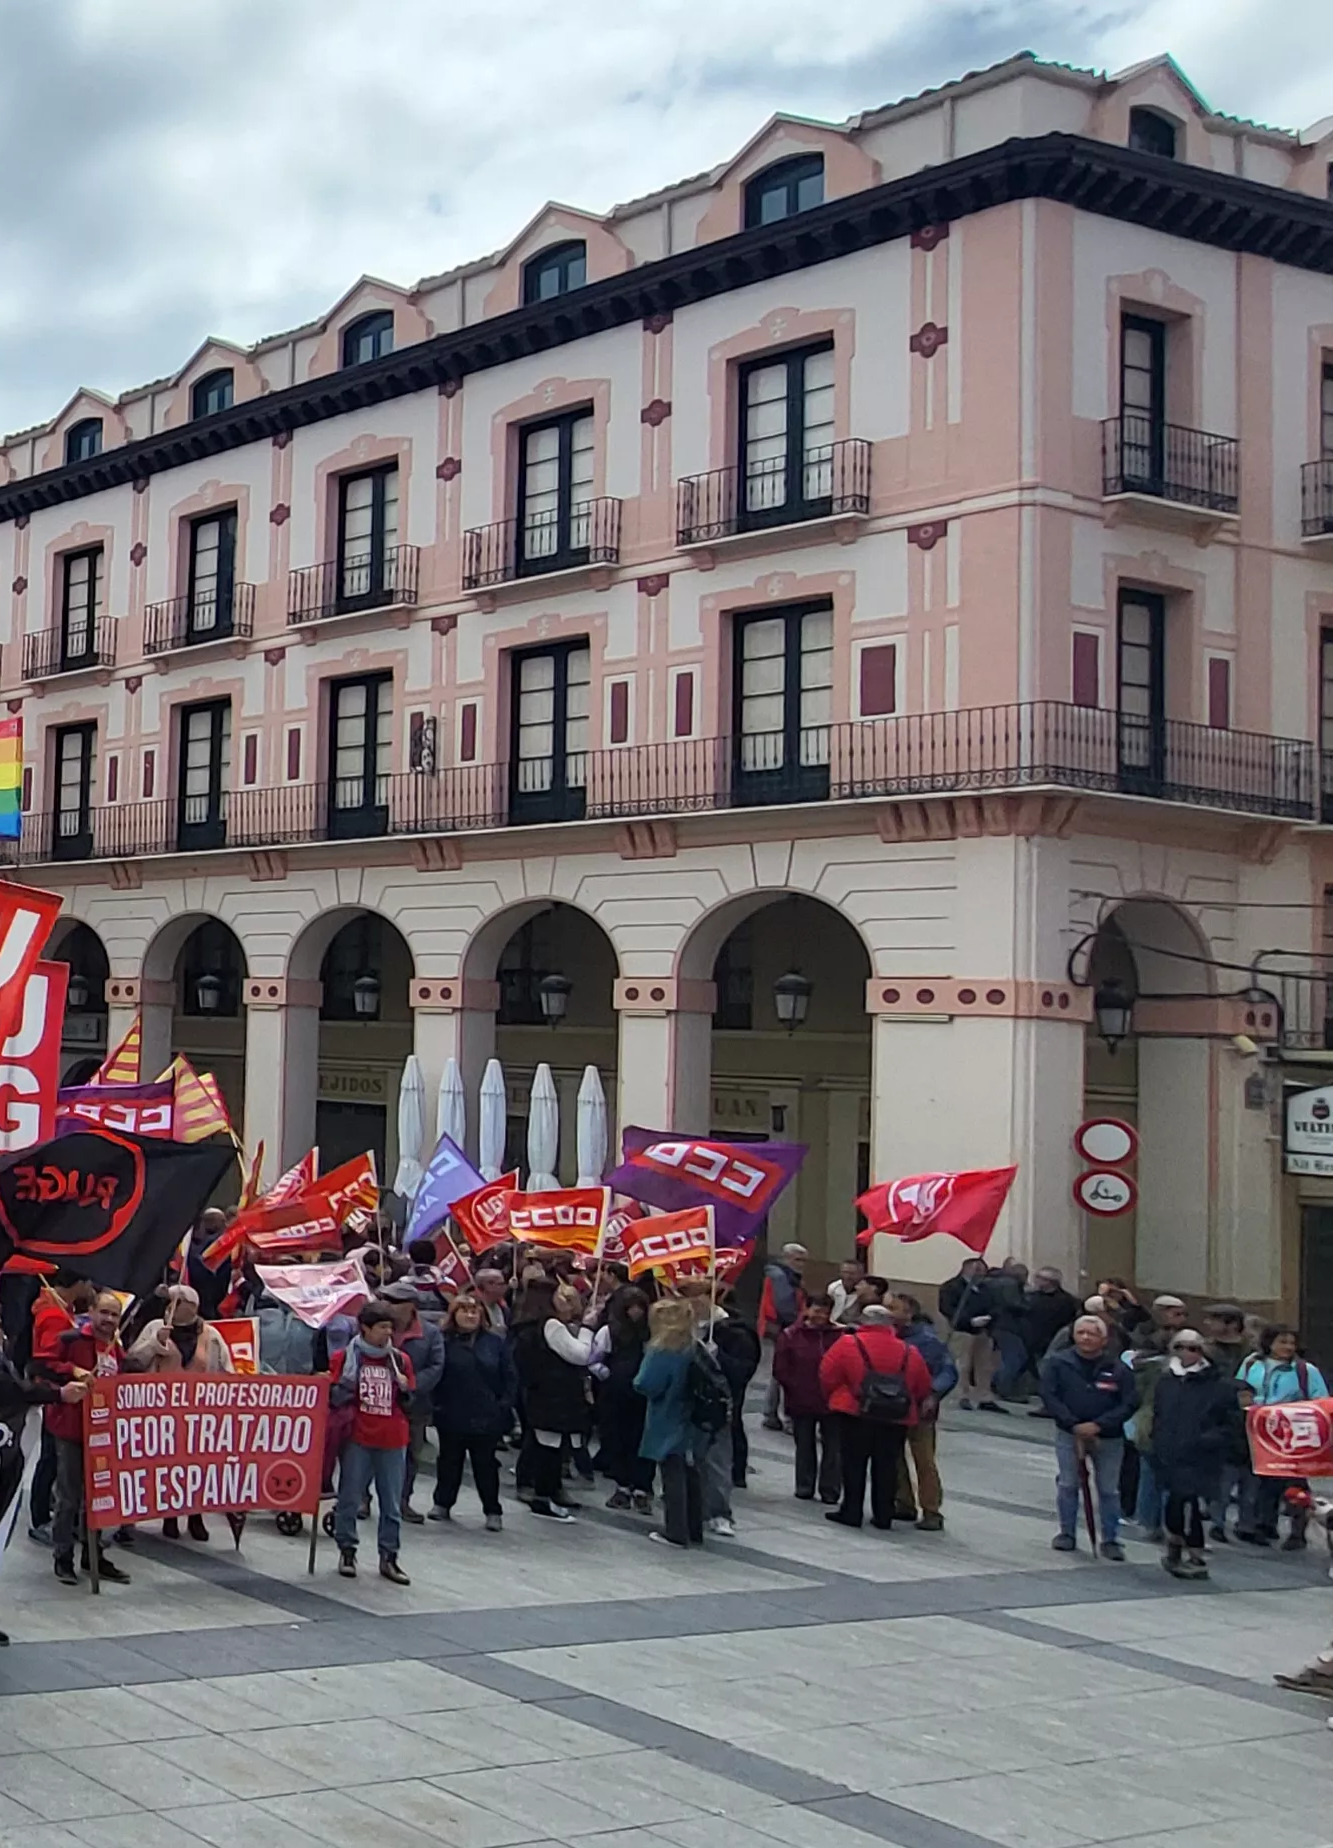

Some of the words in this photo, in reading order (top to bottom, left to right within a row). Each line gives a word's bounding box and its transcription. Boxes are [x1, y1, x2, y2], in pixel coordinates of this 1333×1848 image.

[319, 1074, 382, 1094] EJIDOS
[509, 1205, 598, 1228] CCOO
[116, 1382, 166, 1410] SOMOS
[171, 1382, 190, 1408] EL
[194, 1382, 318, 1409] PROFESORADO
[115, 1414, 176, 1460] PEOR
[184, 1413, 314, 1454] TRATADO
[118, 1468, 149, 1518] DE
[156, 1455, 259, 1512] ESPAÑA
